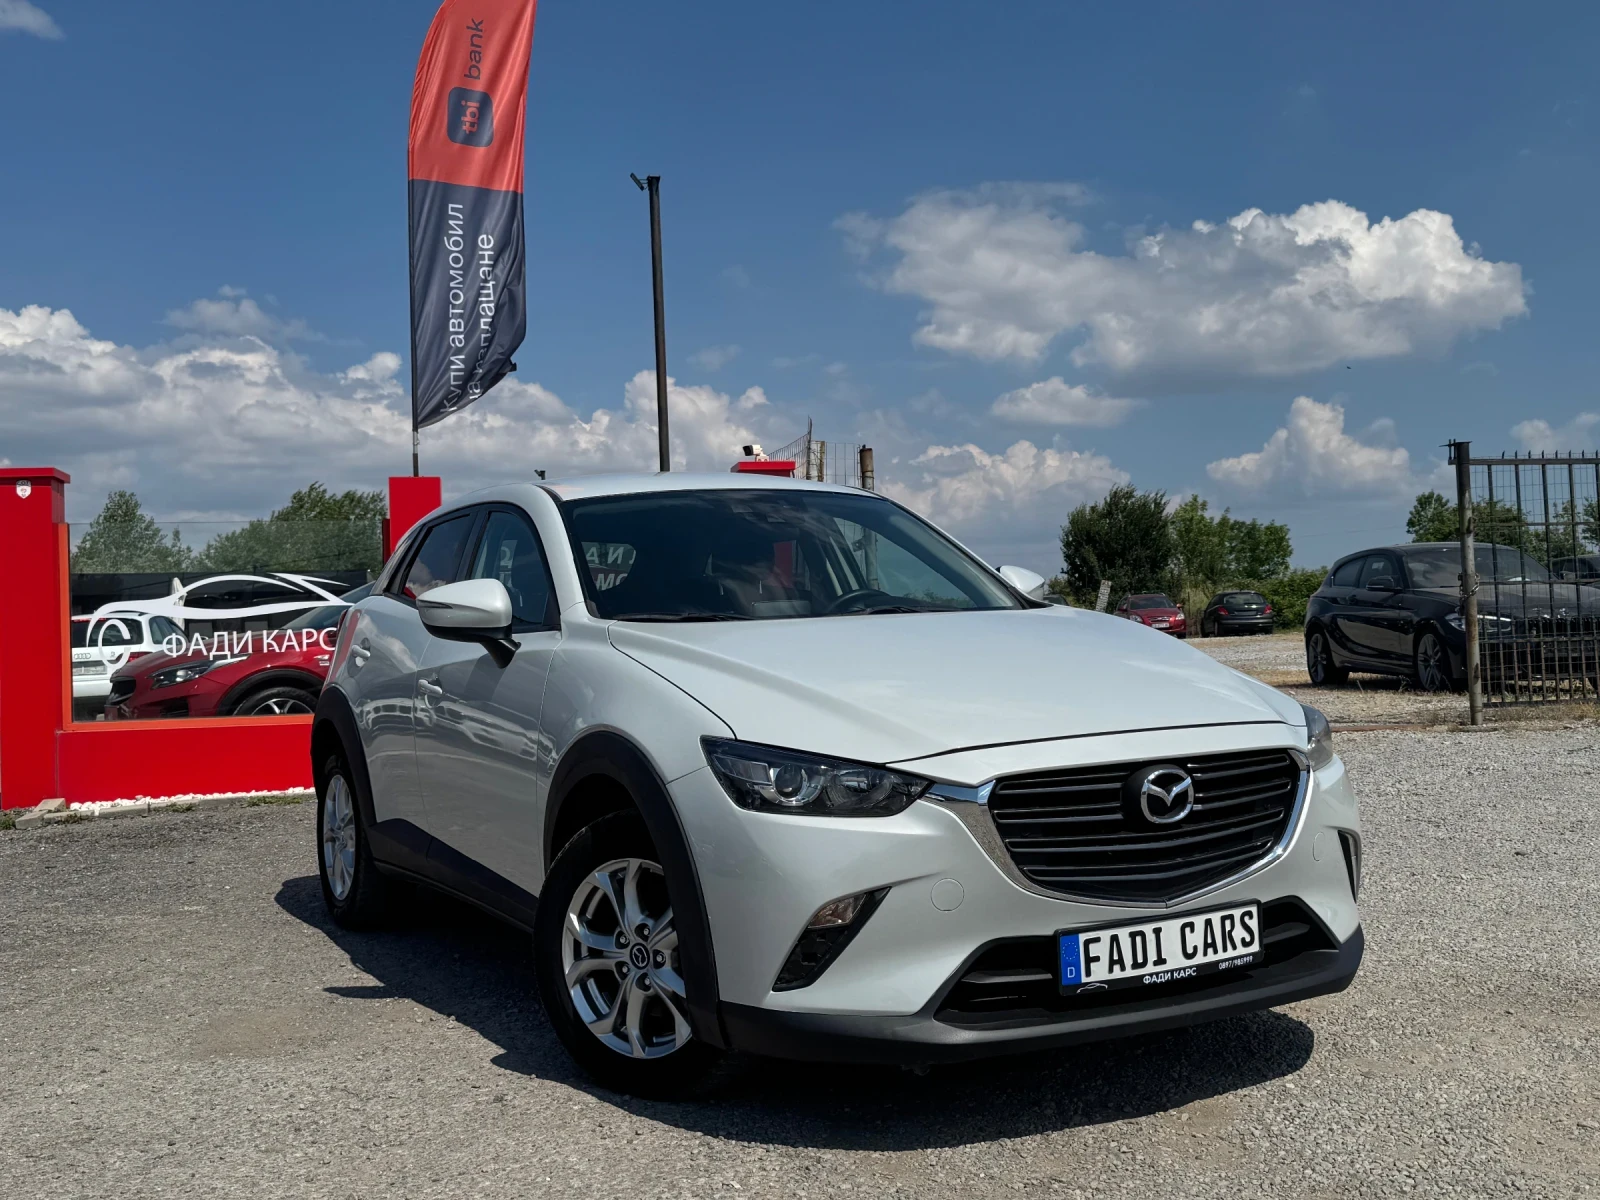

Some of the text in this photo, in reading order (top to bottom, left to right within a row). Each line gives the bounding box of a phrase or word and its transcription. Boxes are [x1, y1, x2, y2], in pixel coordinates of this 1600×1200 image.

[461, 18, 484, 134] tbi bank
[444, 203, 464, 347] автомобил
[162, 627, 336, 660] ФАДИ КАРС
[1083, 910, 1256, 978] FADI CARS
[1067, 967, 1076, 978] D
[1143, 967, 1197, 984] ФАДИ КАРС
